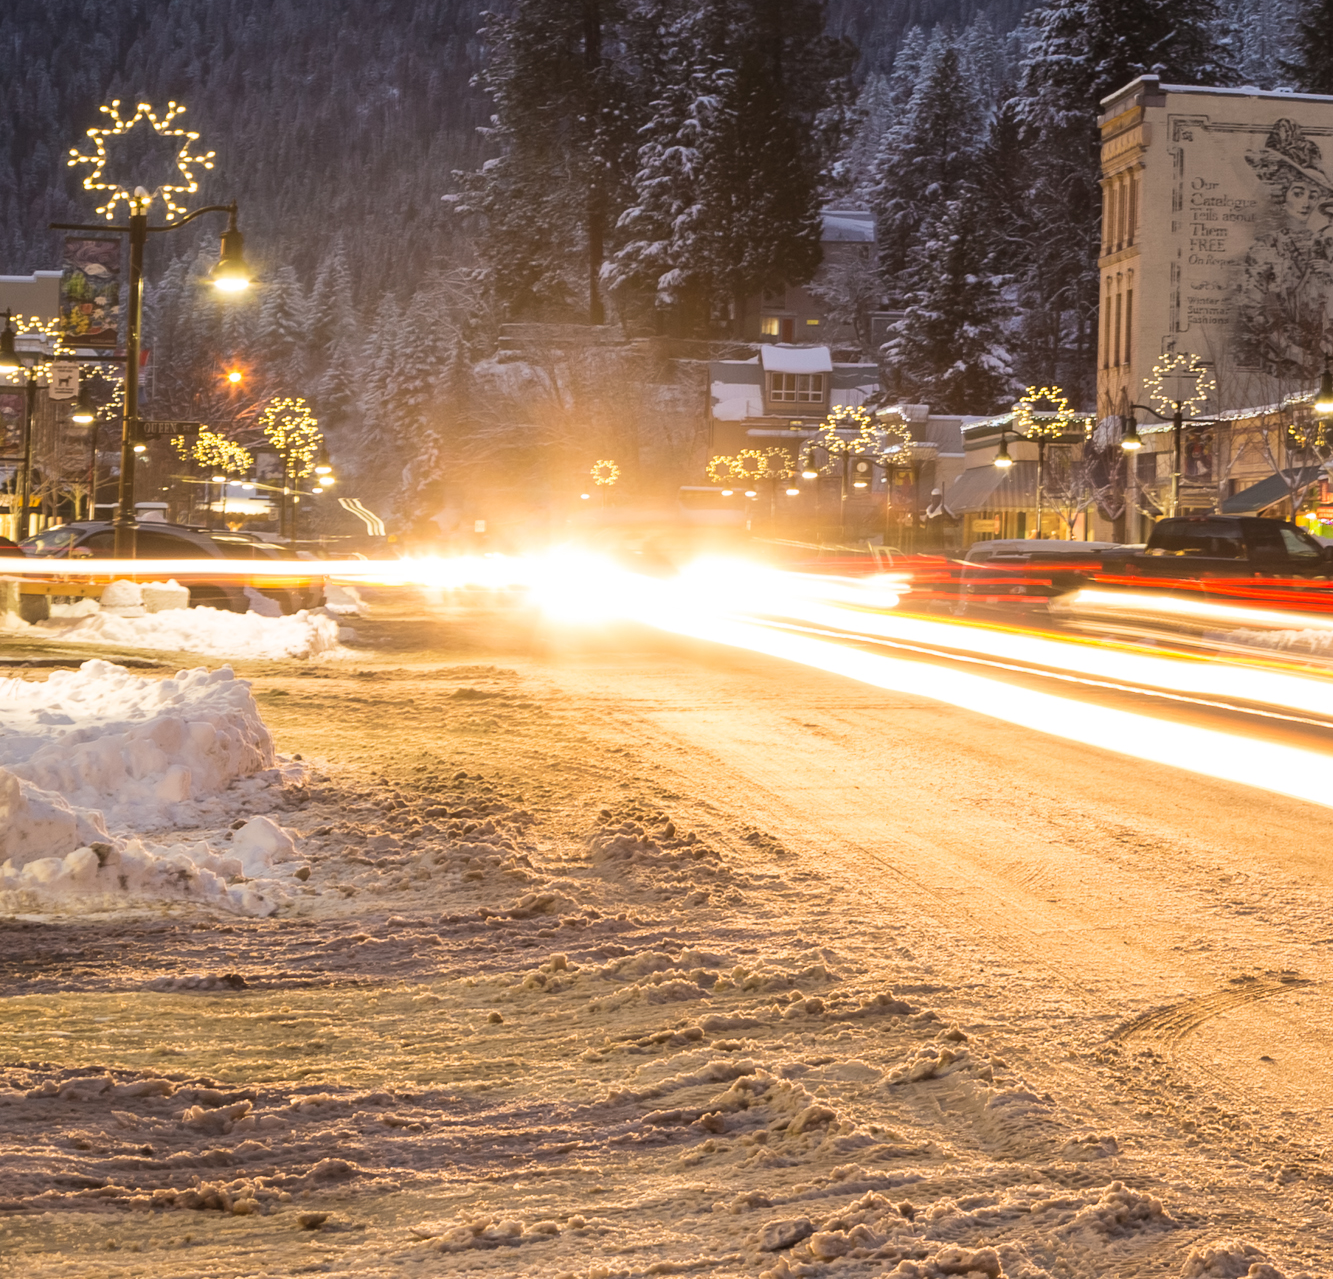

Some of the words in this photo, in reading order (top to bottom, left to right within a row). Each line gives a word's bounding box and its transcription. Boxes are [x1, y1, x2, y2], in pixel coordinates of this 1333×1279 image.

[1191, 177, 1219, 190] Our
[1191, 193, 1256, 211] Catalogue
[1190, 223, 1228, 236] Them
[1190, 239, 1226, 252] FREE
[1189, 254, 1203, 265] On
[144, 423, 177, 434] QUEEN
